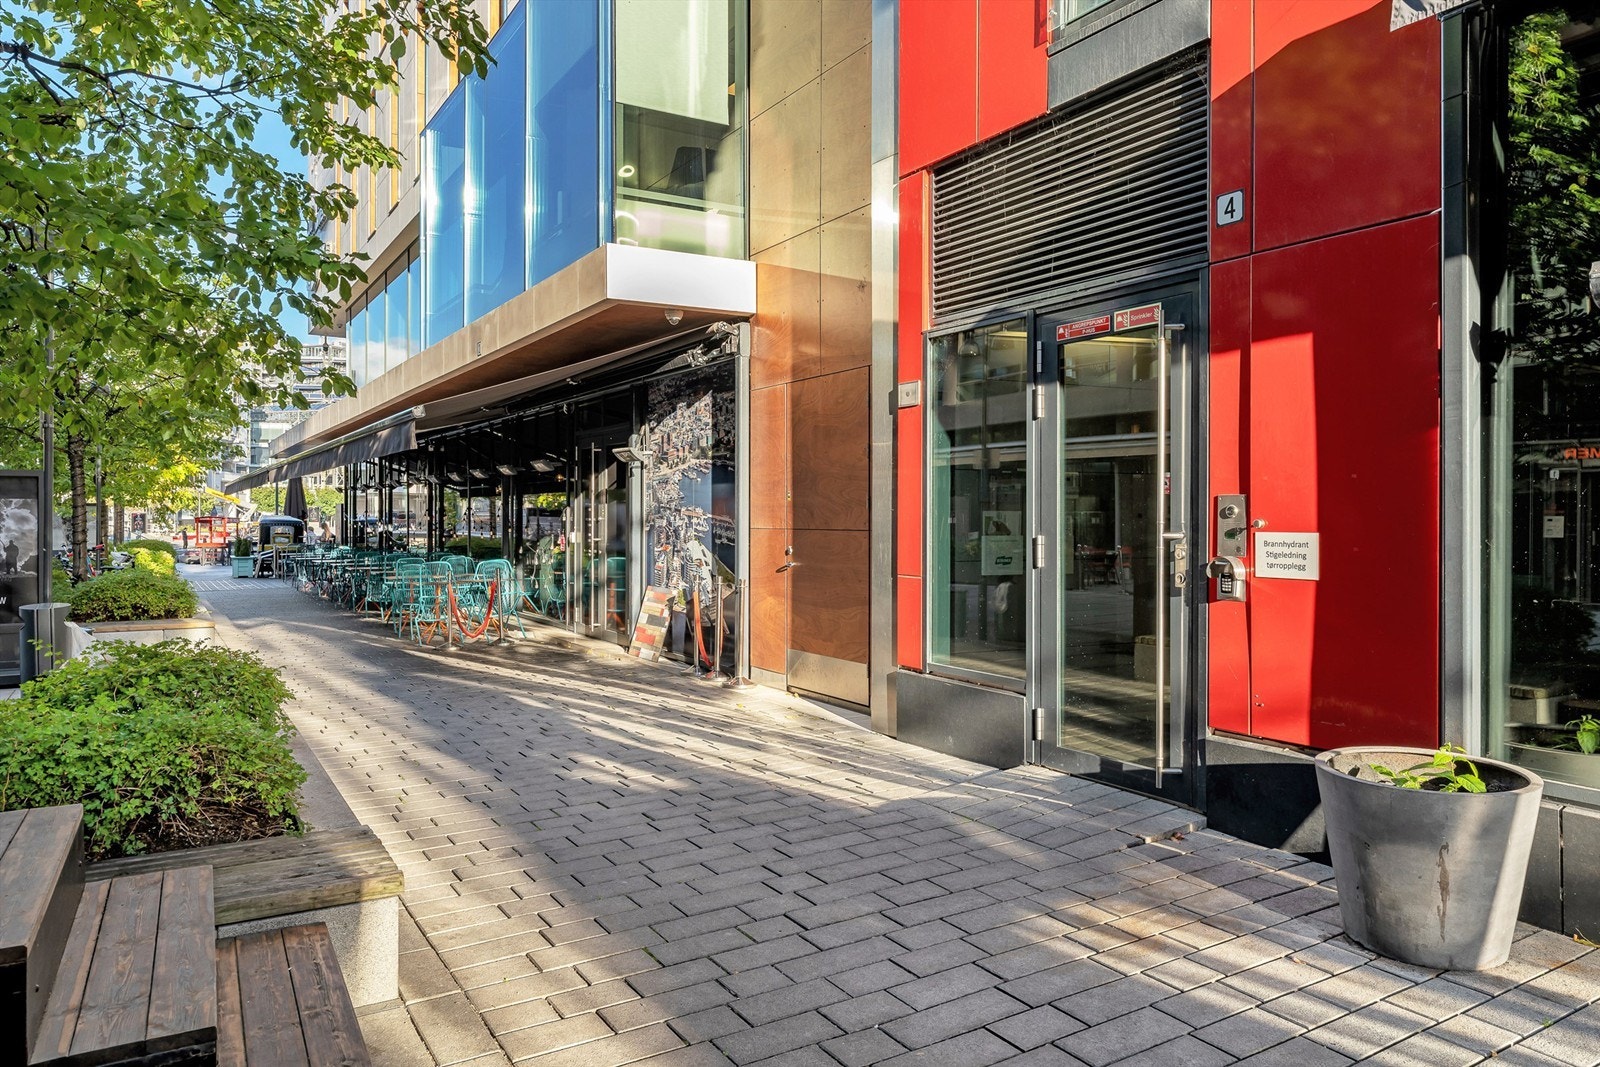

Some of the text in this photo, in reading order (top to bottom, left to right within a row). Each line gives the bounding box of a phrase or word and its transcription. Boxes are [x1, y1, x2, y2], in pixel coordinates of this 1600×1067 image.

[1224, 196, 1236, 219] 4
[1130, 313, 1153, 321] Sprinkler
[1072, 318, 1107, 329] ANGREPSPUNKT
[1263, 540, 1309, 549] Brannhydrant
[1265, 551, 1307, 561] Stigeledning
[1266, 562, 1307, 571] tørropplegg
